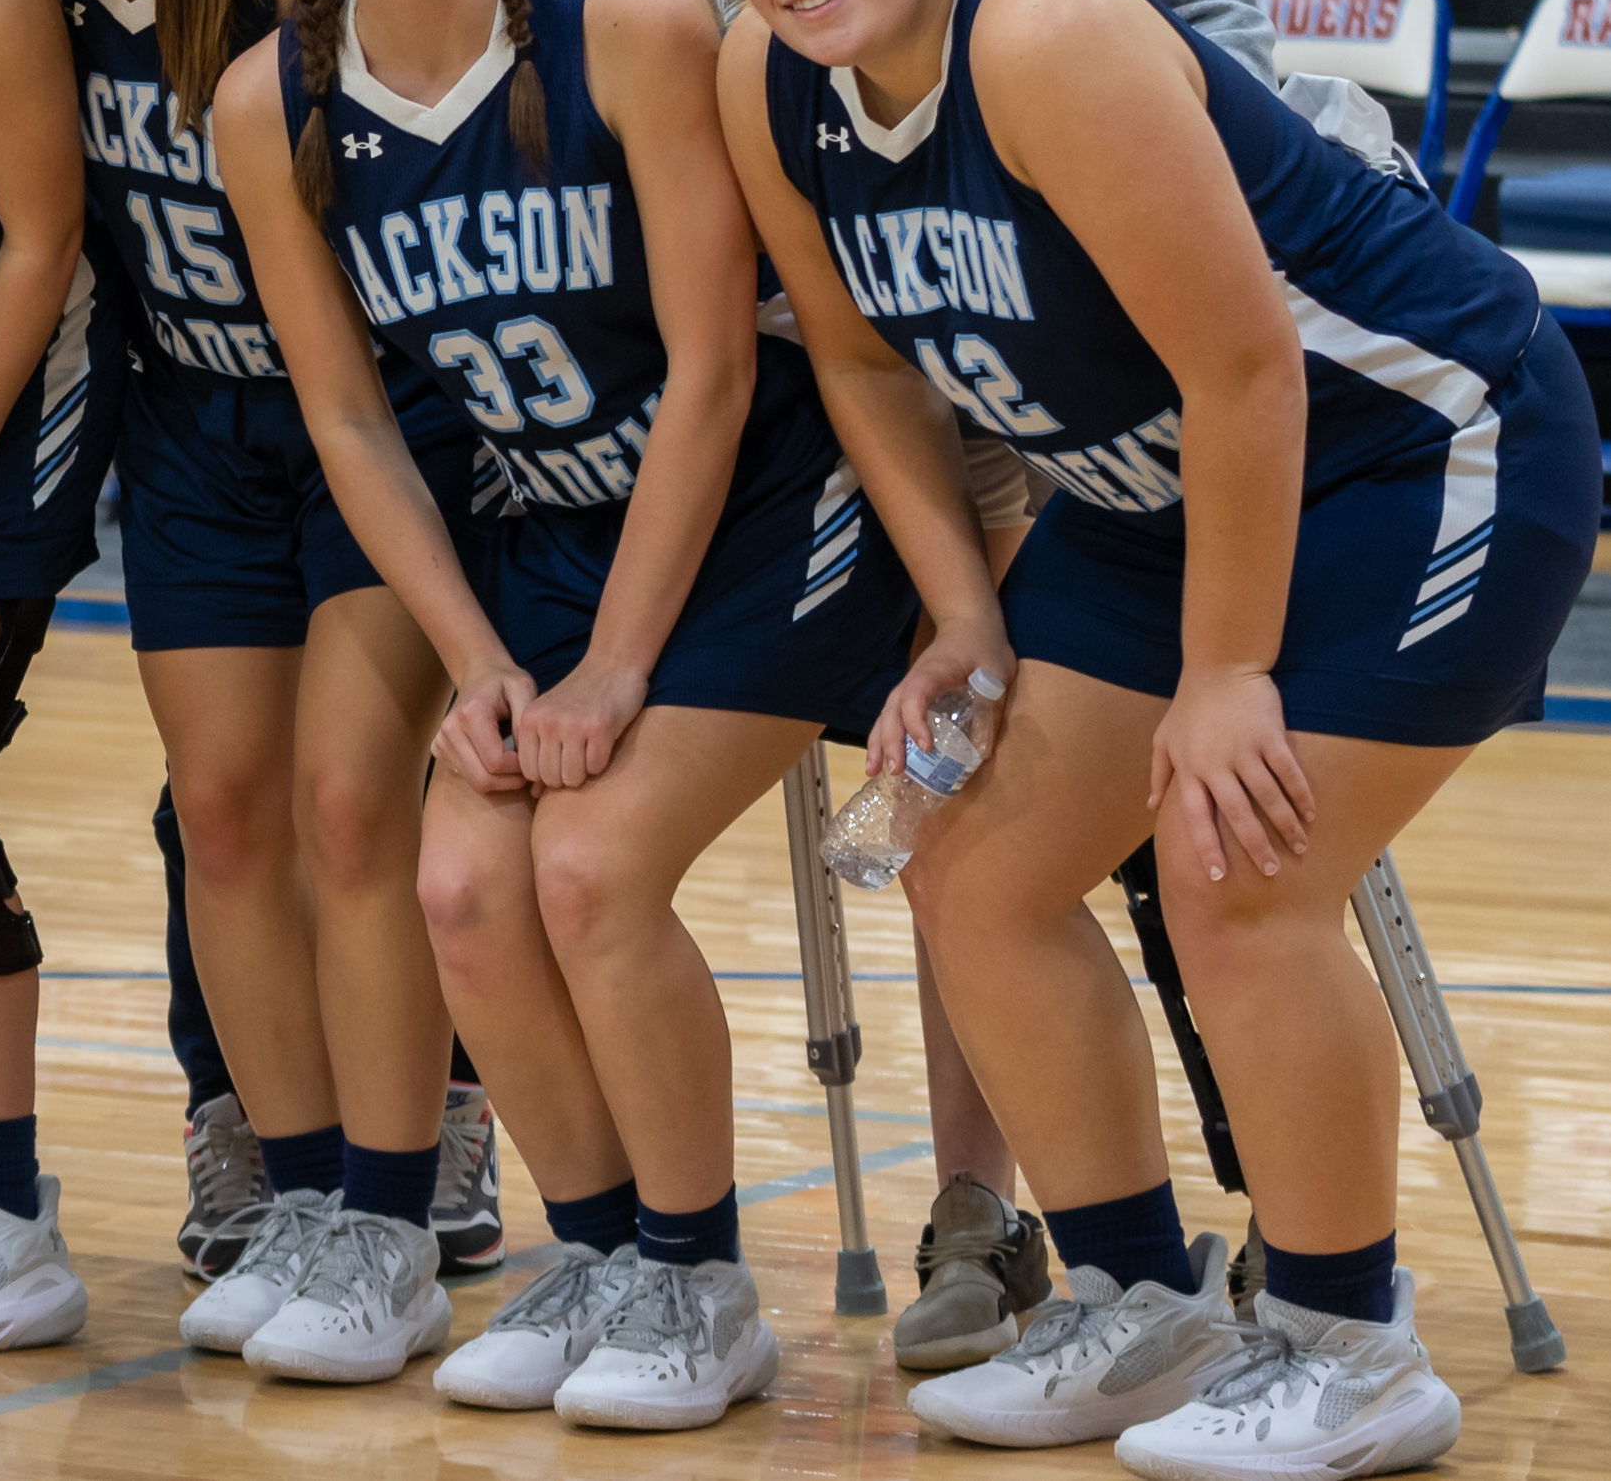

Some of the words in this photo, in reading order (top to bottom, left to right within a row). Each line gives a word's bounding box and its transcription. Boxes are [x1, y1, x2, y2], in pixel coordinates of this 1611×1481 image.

[127, 190, 246, 305] 15
[345, 182, 613, 325] ACKSON
[829, 207, 1035, 320] ACKSON
[428, 314, 595, 432] 33
[914, 334, 1066, 437] 42
